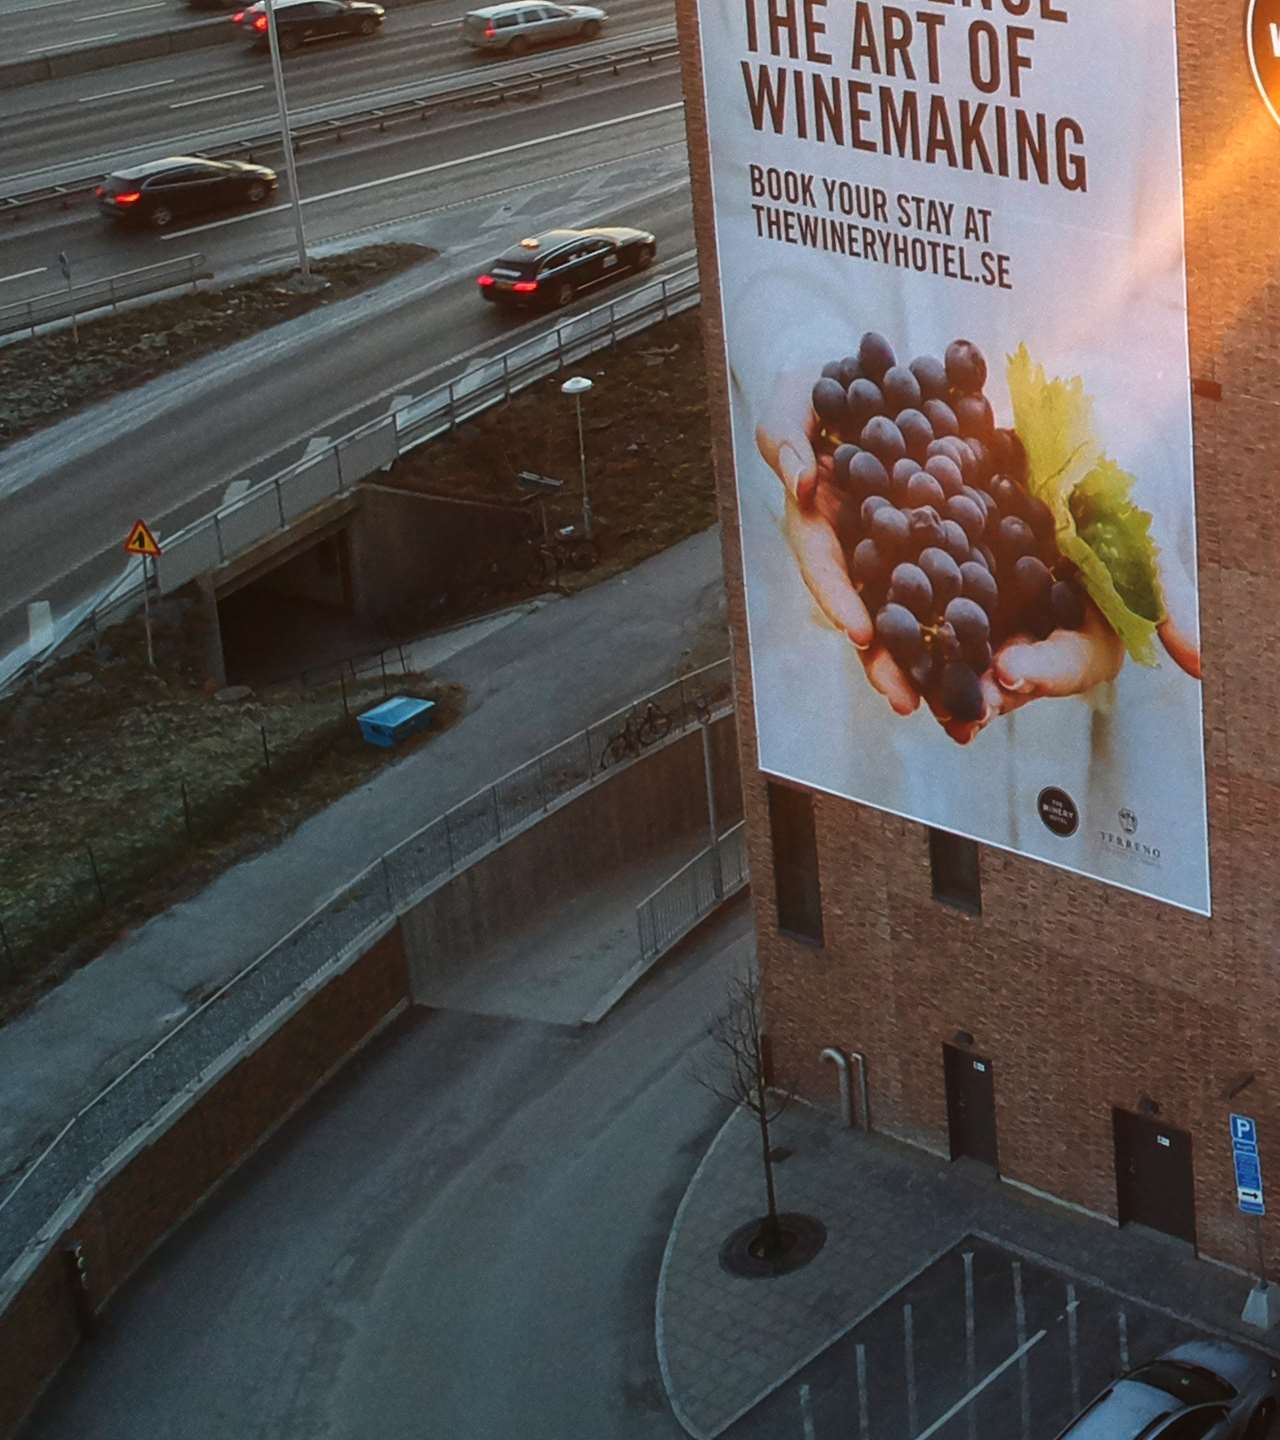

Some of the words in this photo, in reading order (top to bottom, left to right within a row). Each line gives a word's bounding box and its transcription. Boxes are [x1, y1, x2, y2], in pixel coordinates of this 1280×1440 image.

[852, 1, 945, 84] ART
[968, 19, 1034, 98] OF
[740, 61, 1087, 193] WINEMAKING
[749, 165, 817, 209] BOOK
[822, 178, 888, 223] YOUR
[897, 194, 954, 235] STAY
[965, 207, 992, 243] AT
[752, 204, 1012, 289] THEWINERYHOTEL.SE
[1100, 831, 1160, 858] TERRENO
[1237, 1118, 1250, 1138] P
